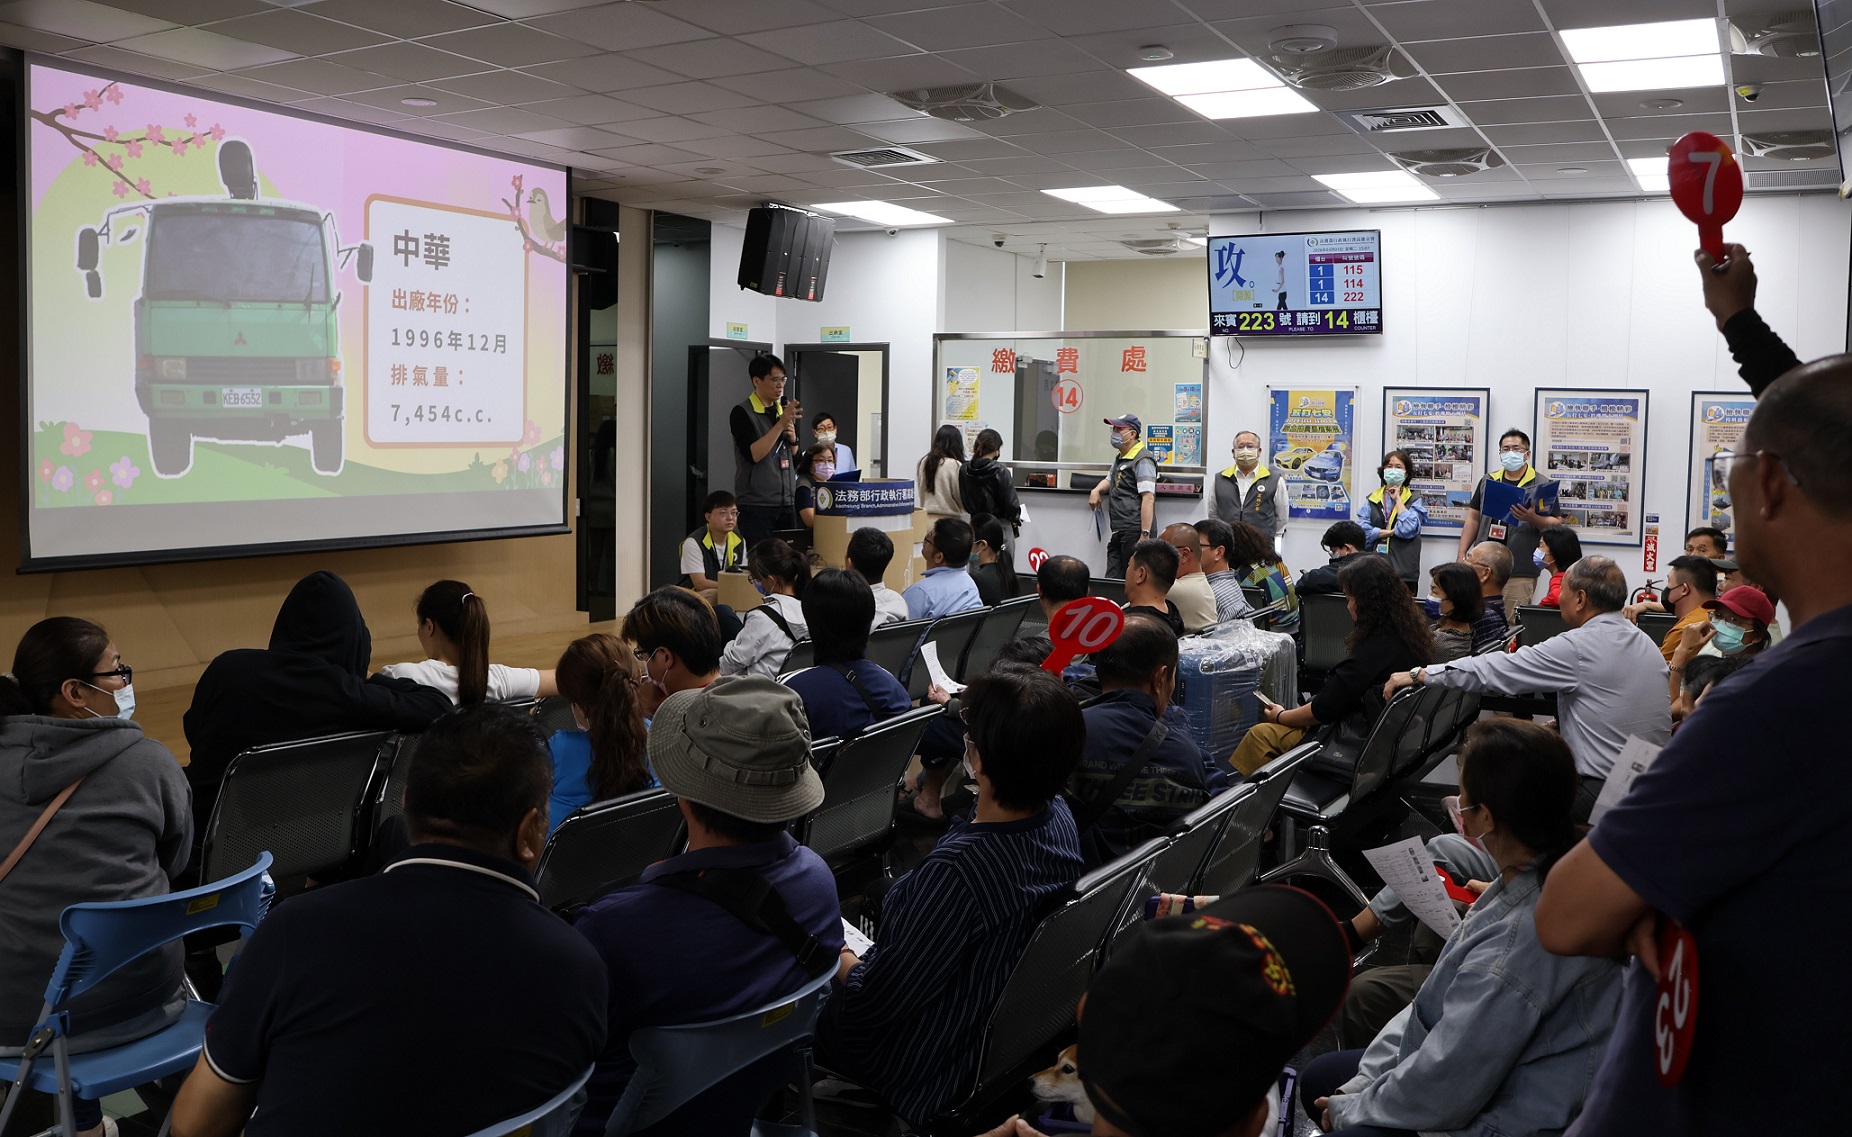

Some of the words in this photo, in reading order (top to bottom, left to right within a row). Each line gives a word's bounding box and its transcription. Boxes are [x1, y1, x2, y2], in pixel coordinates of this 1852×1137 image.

[1688, 151, 1722, 216] 7
[393, 228, 451, 270] 中華
[1317, 265, 1324, 276] 1
[1343, 264, 1364, 275] 115
[1318, 279, 1324, 290] 1
[1343, 278, 1364, 289] 114
[391, 287, 470, 315] 出廠年份：
[1314, 292, 1329, 303] 14
[1343, 291, 1364, 302] 222
[1213, 313, 1237, 327] 來賓
[1239, 312, 1276, 331] 223
[1278, 312, 1292, 326] 號
[1296, 311, 1321, 326] 請到
[1324, 310, 1350, 330] 14
[391, 327, 507, 354] 1996年12月
[991, 346, 1147, 374] 繳費處
[1055, 386, 1078, 407] 14
[391, 404, 492, 426] 7,454c.c.
[1060, 604, 1119, 647] 10
[1655, 938, 1690, 1075] 23
